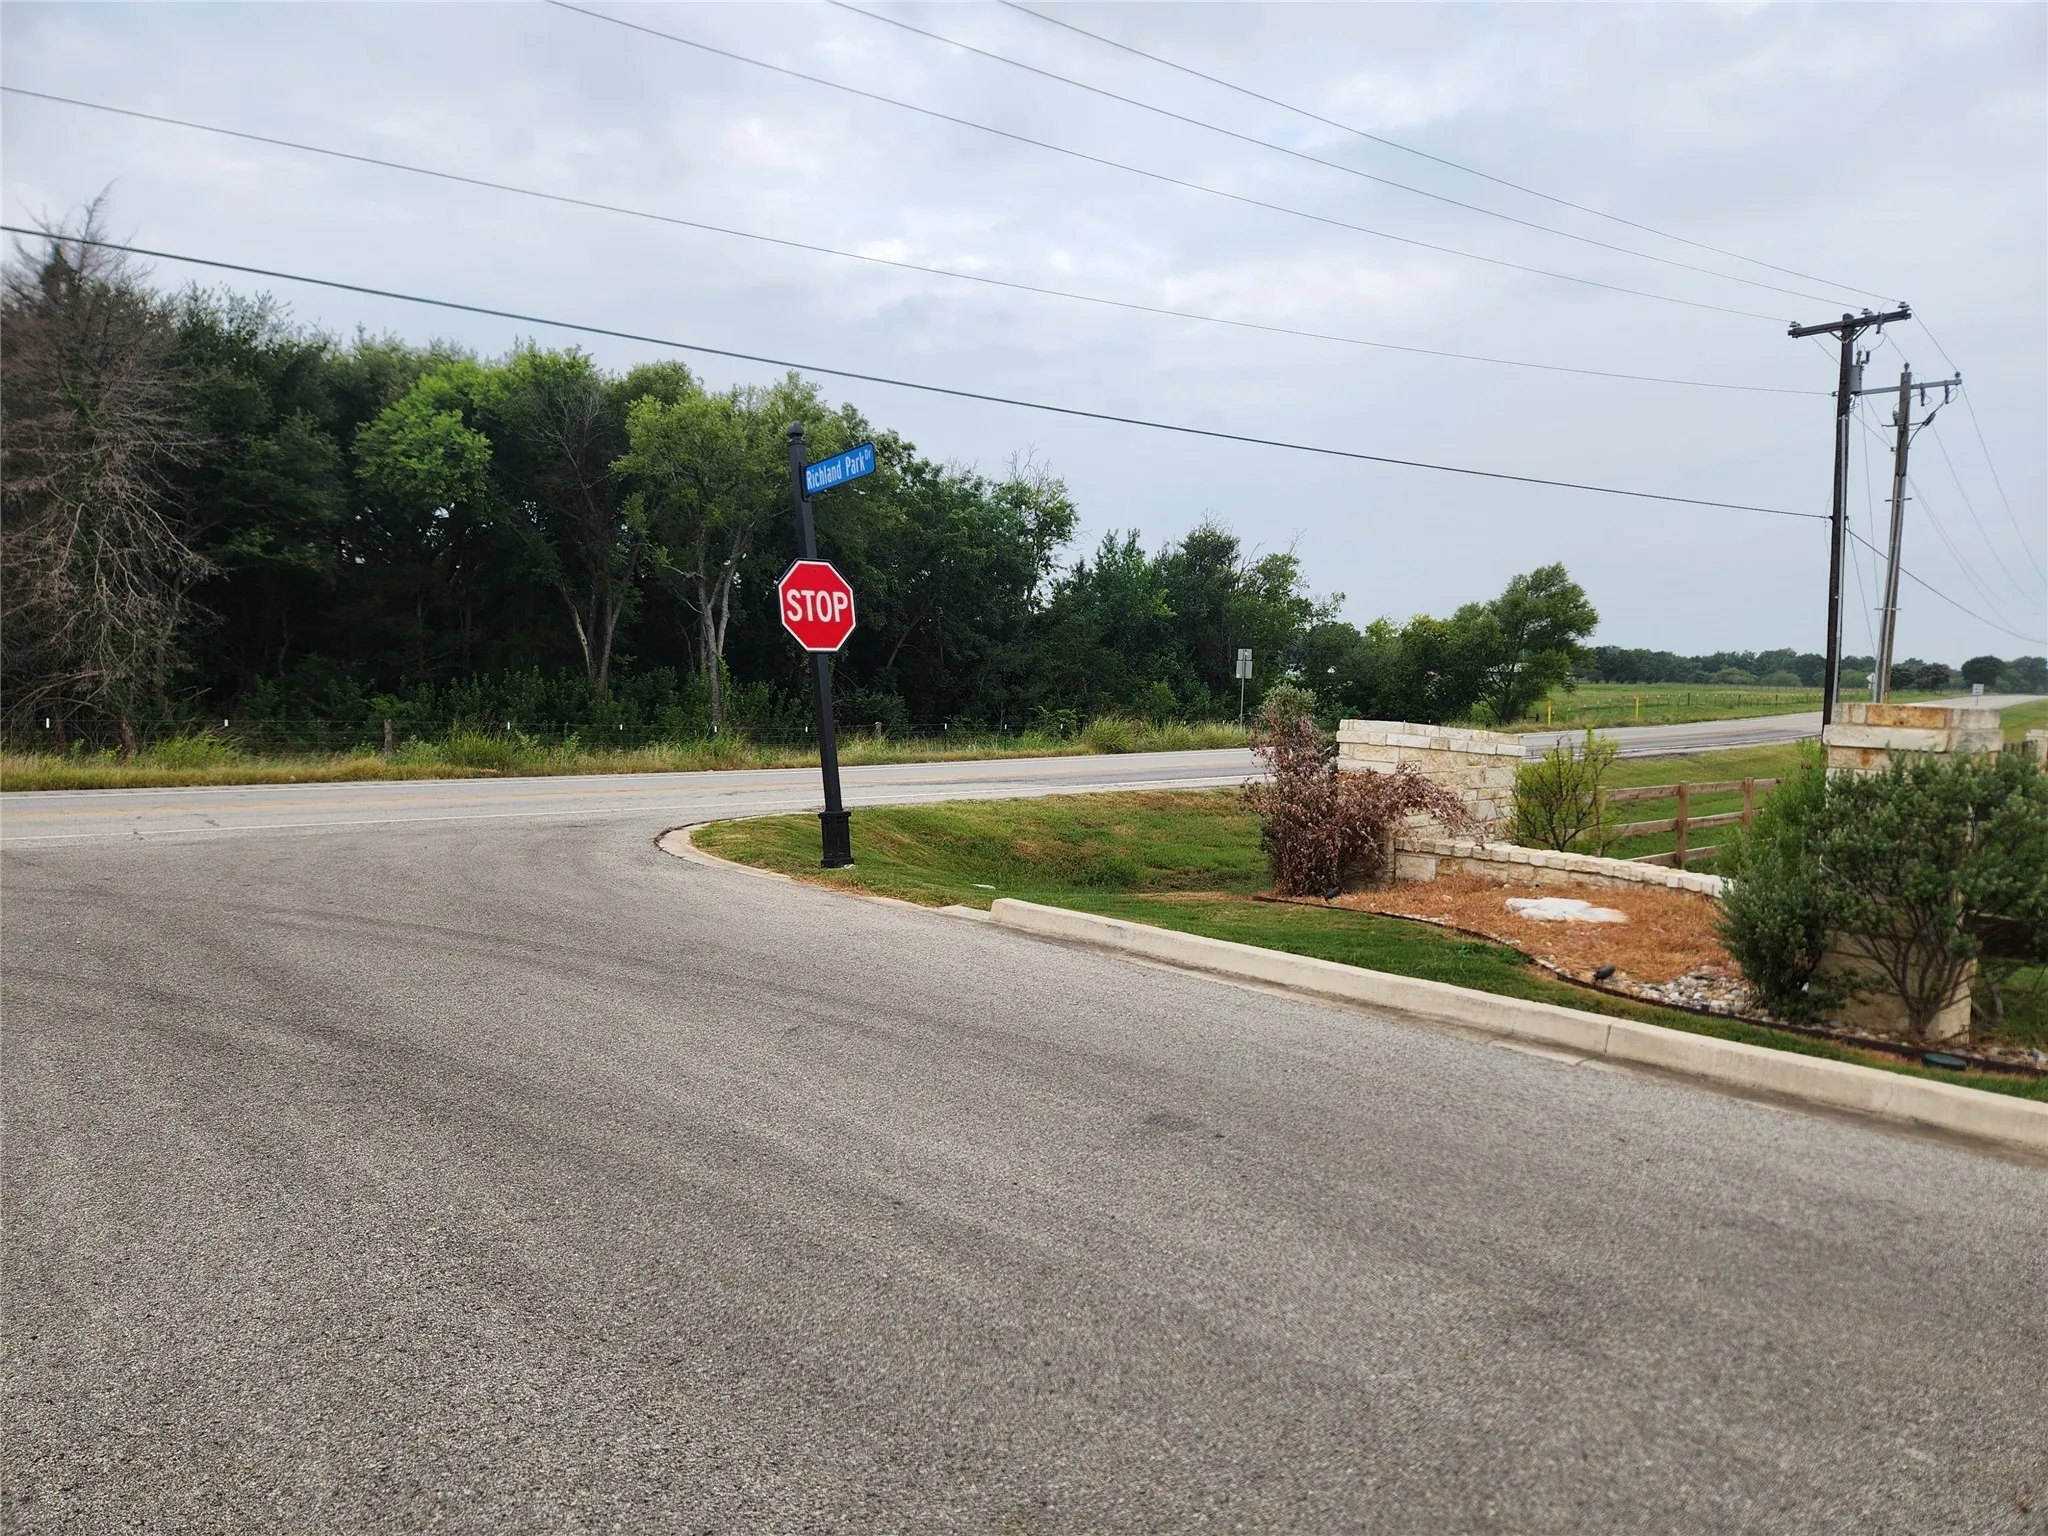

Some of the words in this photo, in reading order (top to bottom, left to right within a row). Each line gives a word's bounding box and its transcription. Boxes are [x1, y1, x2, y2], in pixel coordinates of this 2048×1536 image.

[806, 460, 842, 490] Richland
[845, 452, 865, 476] Park
[786, 589, 848, 623] STOP
